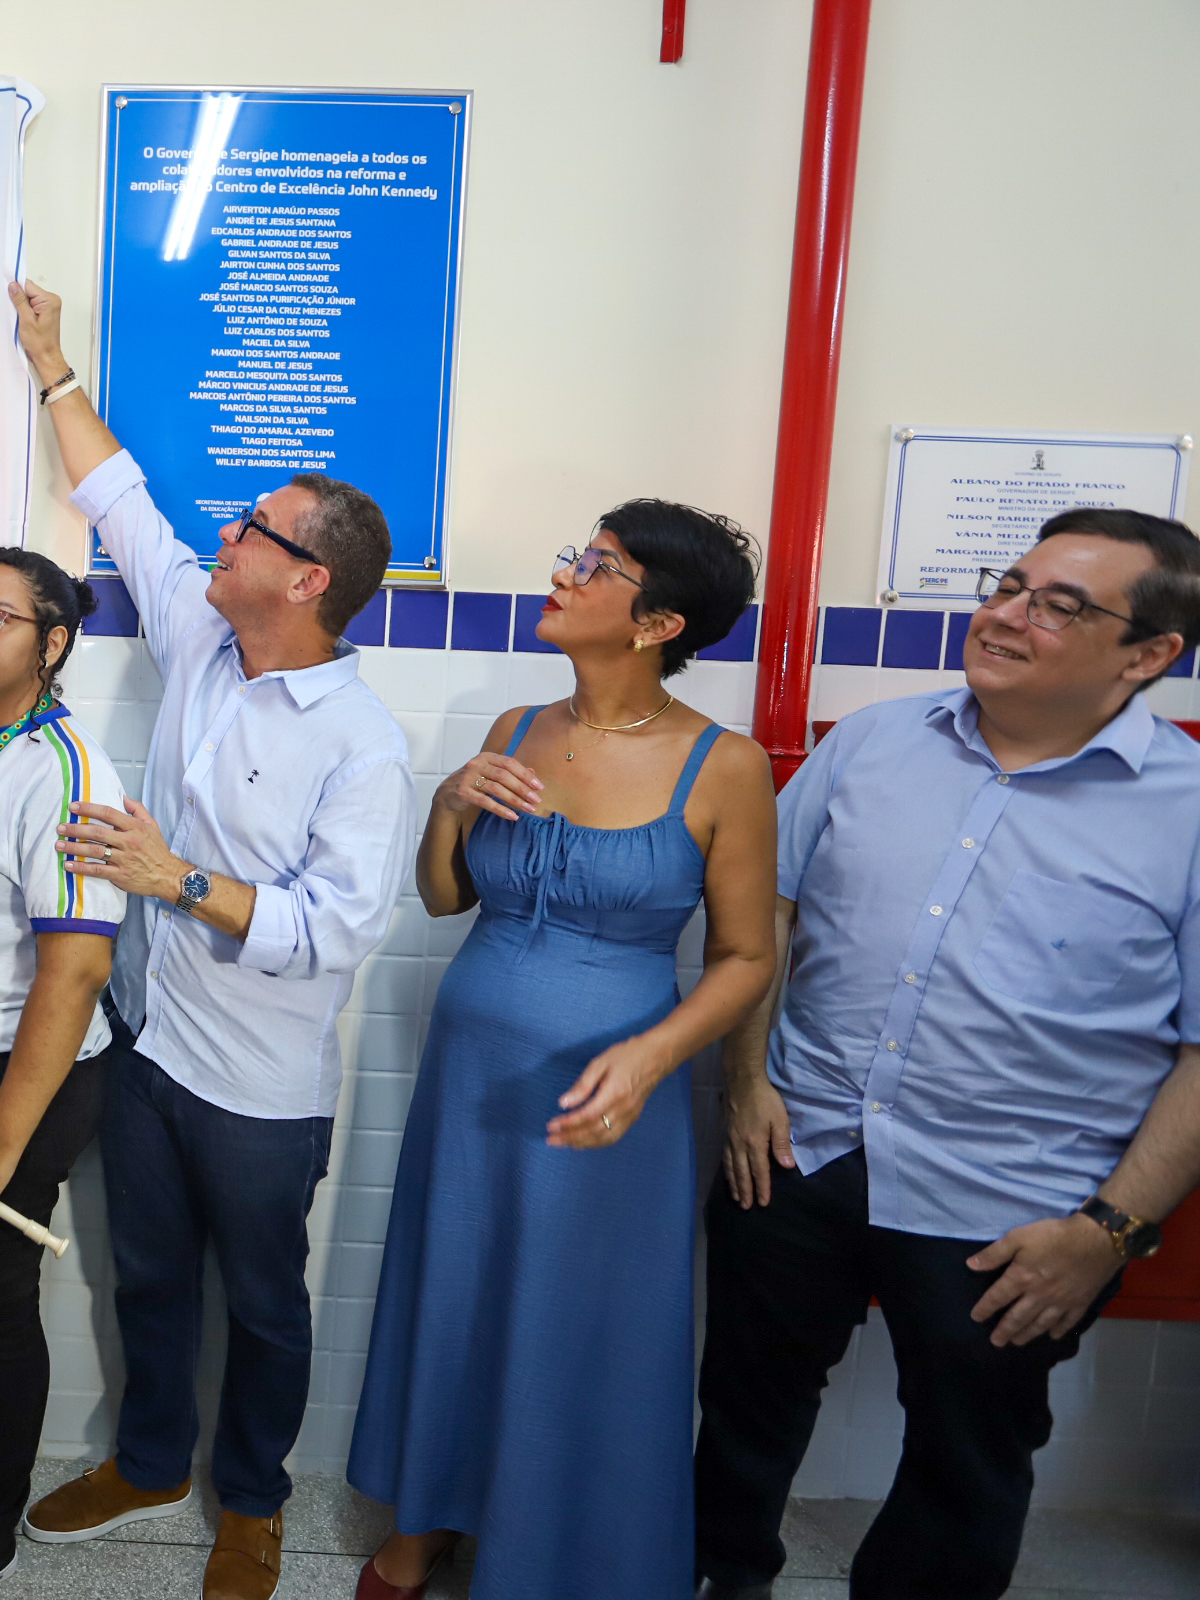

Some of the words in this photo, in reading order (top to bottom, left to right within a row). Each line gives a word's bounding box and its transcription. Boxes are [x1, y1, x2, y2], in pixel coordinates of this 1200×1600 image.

[143, 147, 154, 158] O
[156, 147, 209, 160] Gover
[230, 148, 279, 163] Sergipe
[281, 149, 359, 165] homenageia
[361, 154, 370, 163] a
[372, 152, 409, 164] todos
[411, 155, 428, 165] os
[255, 166, 324, 178] envolvidos
[326, 169, 343, 179] na
[345, 168, 396, 180] reforma
[398, 171, 407, 180] e
[215, 181, 258, 193] Centro
[260, 182, 277, 193] de
[279, 182, 346, 195] Excelência
[348, 184, 379, 196] John
[381, 185, 438, 200] Kennedy
[223, 205, 271, 214] AIRVERTON
[273, 205, 306, 215] ARAÚJO
[308, 207, 340, 216] PASSOS
[226, 215, 255, 225] ANDRÉ
[256, 217, 268, 226] DE
[269, 218, 294, 226] JESUS
[296, 218, 336, 227] SANTANA
[211, 227, 255, 236] EDCARLOS
[257, 228, 297, 237] ANDRADE
[299, 229, 316, 238] DOS
[318, 230, 351, 239] SANTOS
[222, 239, 256, 248] GABRIEL
[258, 240, 298, 248] ANDRADE
[300, 240, 312, 249] DE
[314, 241, 338, 249] JESUS
[228, 250, 258, 259] GILVAN
[259, 251, 293, 260] SANTOS
[294, 252, 306, 260] DA
[308, 252, 330, 261] SILVA
[220, 261, 256, 270] JAIRTON
[257, 262, 286, 270] CUNHA
[288, 262, 304, 271] DOS
[306, 263, 340, 271] SANTOS
[228, 271, 248, 281] JOSÉ
[250, 273, 286, 282] ALMEIDA
[289, 274, 329, 283] ANDRADE
[219, 282, 240, 291] JOSÉ
[241, 283, 273, 292] MARCIO
[275, 284, 308, 293] SANTOS
[310, 285, 338, 294] SOUZA
[200, 292, 220, 302] JOSÉ
[221, 294, 255, 303] SANTOS
[256, 295, 268, 303] DA
[270, 294, 324, 305] PURIFICAÇÃO
[325, 296, 355, 305] JÚNIOR
[213, 304, 236, 313] JÚLIO
[238, 305, 264, 314] CESAR
[266, 306, 278, 314] DA
[280, 306, 300, 315] CRUZ
[302, 307, 341, 316] MENEZES
[227, 316, 245, 325] LUIZ
[247, 316, 285, 326] ANTÔNIO
[286, 318, 298, 326] DE
[300, 318, 327, 327] SOUZA
[224, 327, 242, 335] LUIZ
[244, 327, 276, 336] CARLOS
[278, 328, 295, 337] DOS
[296, 329, 330, 338] SANTOS
[242, 338, 272, 347] MACIEL
[274, 339, 286, 348] DA
[288, 340, 310, 348] SILVA
[212, 348, 244, 357] MAIKON
[246, 349, 263, 358] DOS
[265, 350, 298, 359] SANTOS
[300, 351, 340, 360] ANDRADE
[238, 360, 272, 369] MANUEL
[275, 361, 286, 369] DE
[288, 362, 312, 370] JESUS
[206, 370, 245, 379] MARCELO
[246, 371, 288, 381] MESQUITA
[290, 373, 307, 381] DOS
[309, 373, 342, 382] SANTOS
[198, 380, 230, 390] MÁRCIO
[268, 383, 309, 392] ANDRADE
[310, 384, 322, 392] DE
[324, 384, 348, 393] JESUS
[190, 392, 226, 401] MARCOIS
[228, 392, 266, 402] ANTÔNIO
[268, 394, 302, 403] PEREIRA
[304, 395, 321, 404] DOS
[323, 396, 356, 405] SANTOS
[220, 404, 254, 413] MARCOS
[256, 405, 268, 413] DA
[270, 405, 292, 414] SILVA
[294, 406, 327, 415] SANTOS
[235, 415, 271, 424] NAILSON
[272, 416, 284, 424] DA
[286, 416, 308, 425] SILVA
[211, 425, 242, 434] THIAGO
[243, 426, 256, 434] DO
[258, 426, 292, 436] AMARAL
[295, 428, 334, 437] AZEVEDO
[242, 437, 266, 446] TIAGO
[268, 438, 302, 447] FEITOSA
[208, 447, 260, 456] WANDERSON
[262, 448, 279, 457] DOS
[280, 449, 314, 458] SANTOS
[315, 450, 335, 459] LIMA
[216, 458, 246, 467] WILLEY
[248, 459, 286, 468] BARBOSA
[288, 460, 300, 468] DE
[302, 461, 326, 469] JESUS
[950, 478, 1001, 486] ALBANO
[1075, 482, 1126, 490] FRANCO
[936, 548, 1010, 556] MARGARIDA
